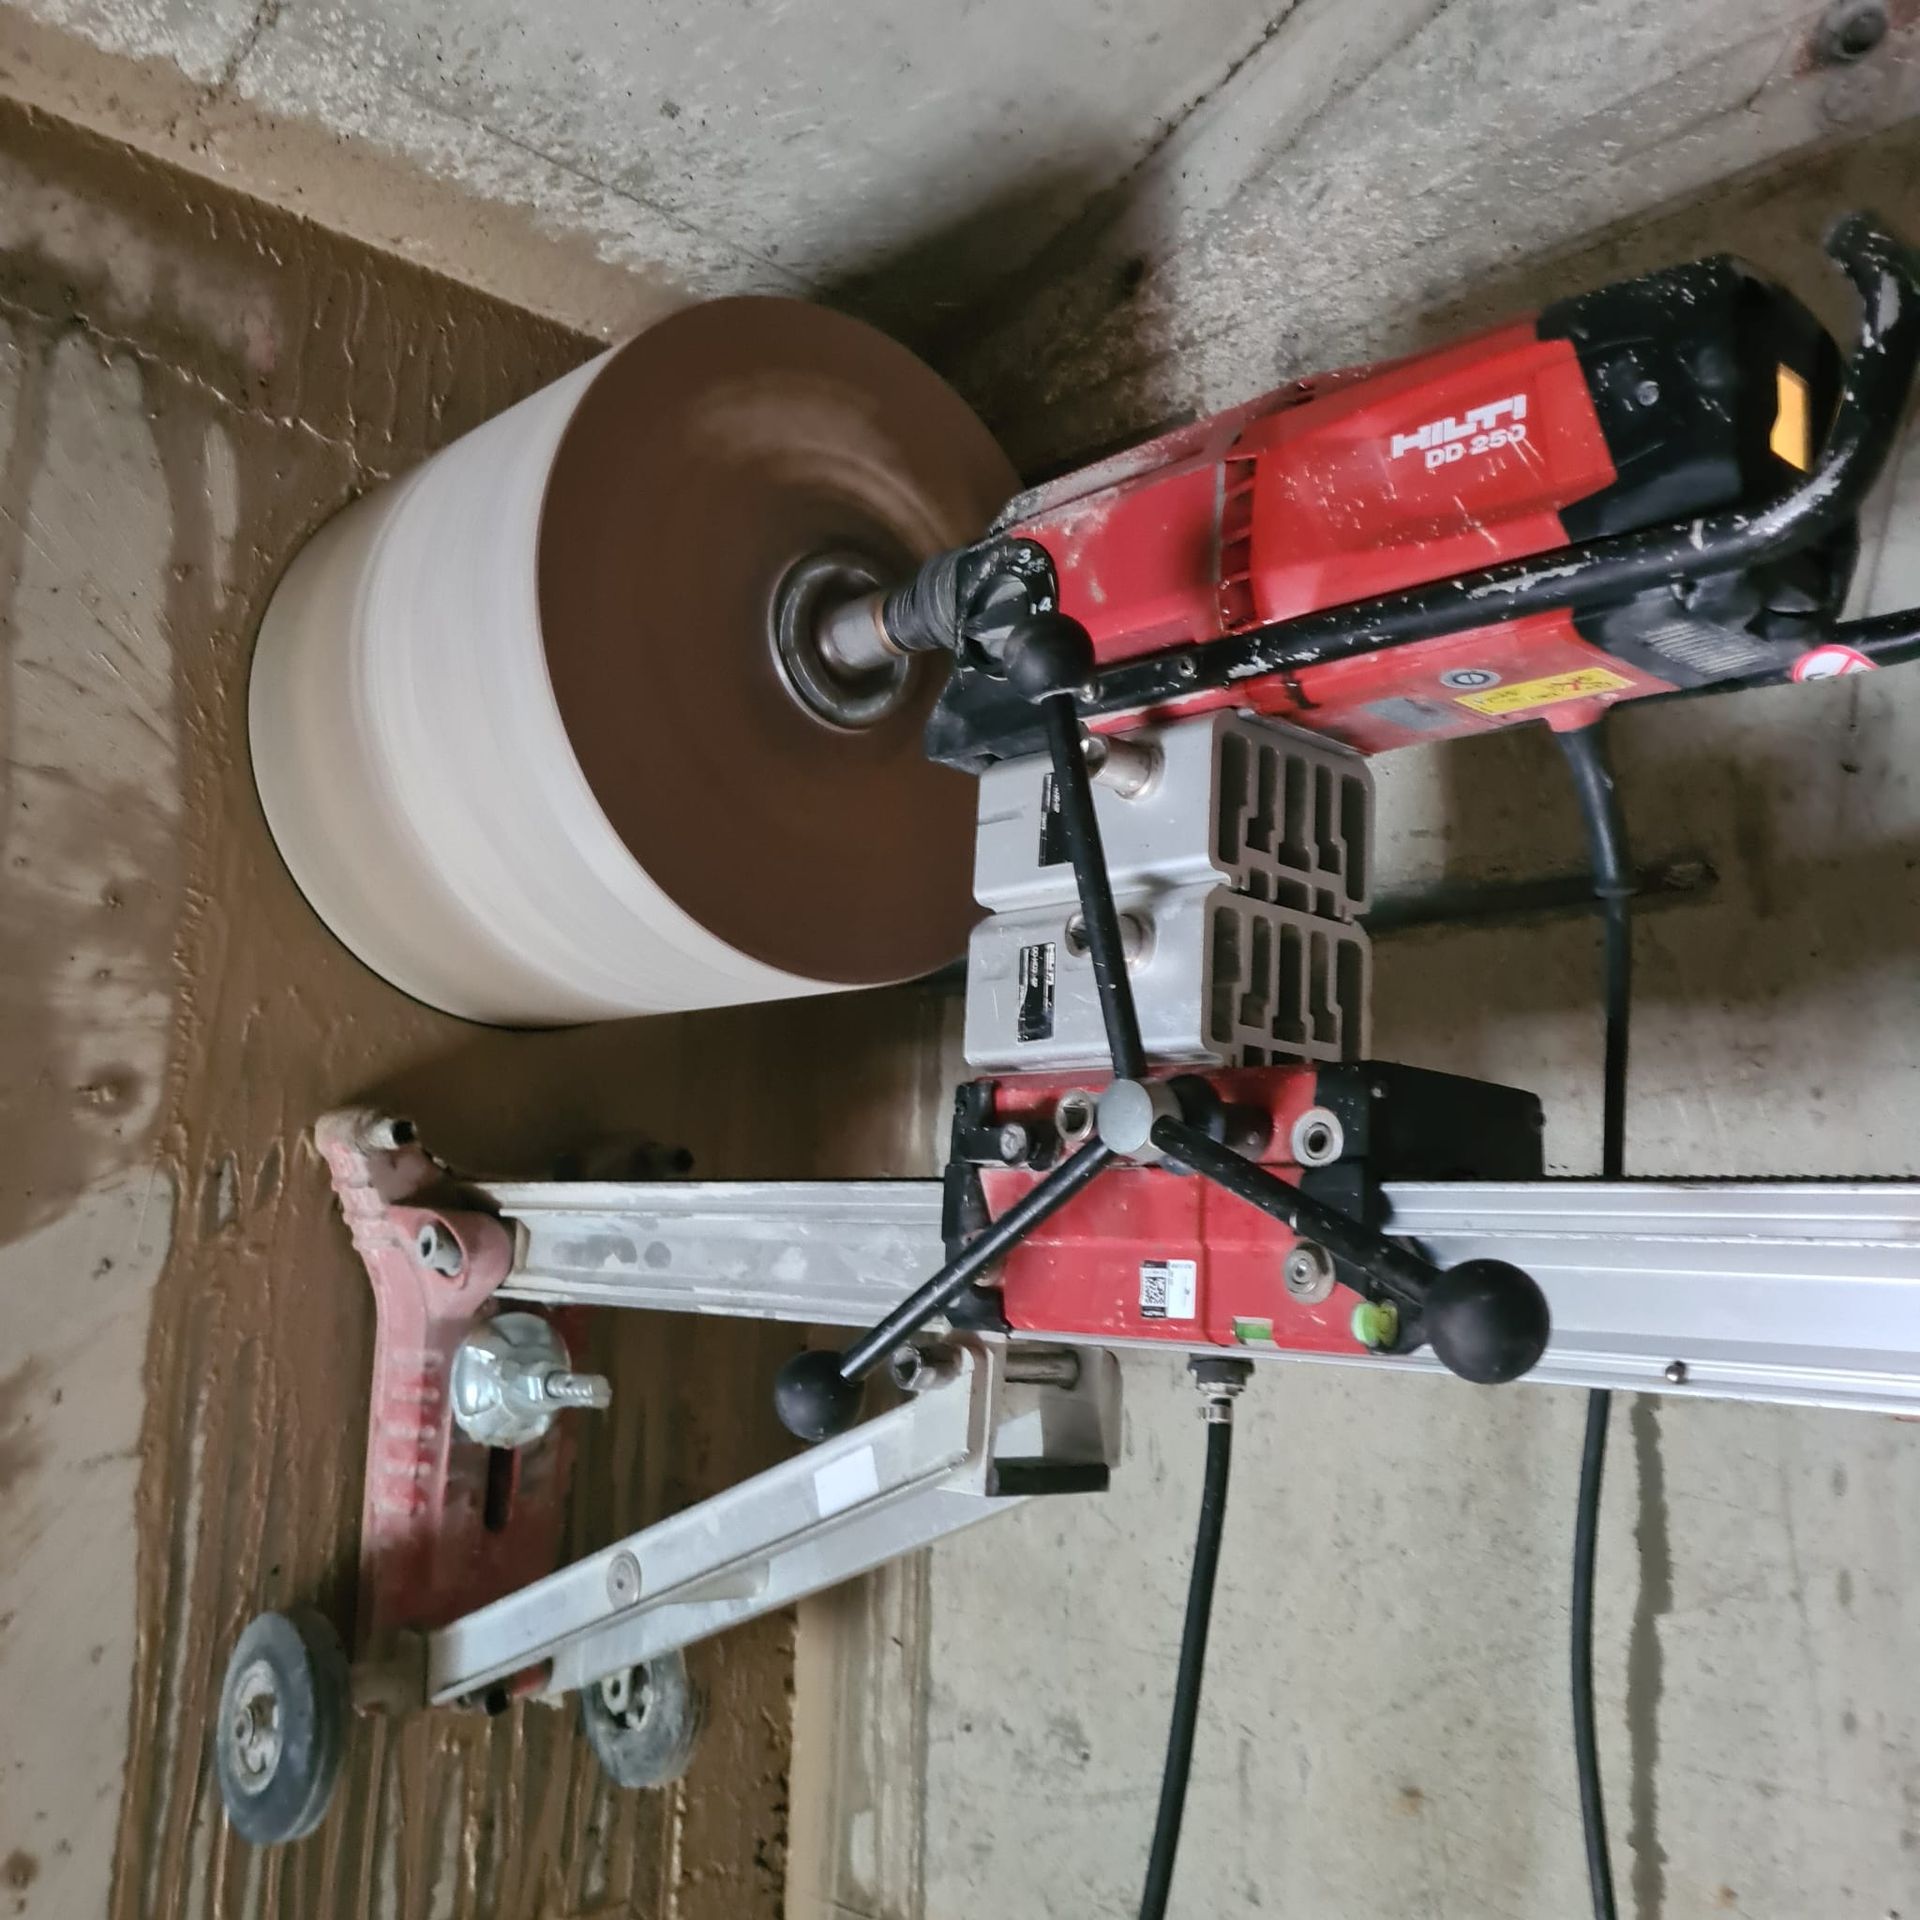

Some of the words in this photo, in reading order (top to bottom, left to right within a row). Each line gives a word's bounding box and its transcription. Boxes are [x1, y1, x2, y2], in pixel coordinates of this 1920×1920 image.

[1391, 394, 1527, 459] HILTI
[1425, 442, 1465, 469] DD
[1470, 424, 1526, 455] 250
[1018, 548, 1032, 564] 3
[1038, 596, 1052, 612] 4
